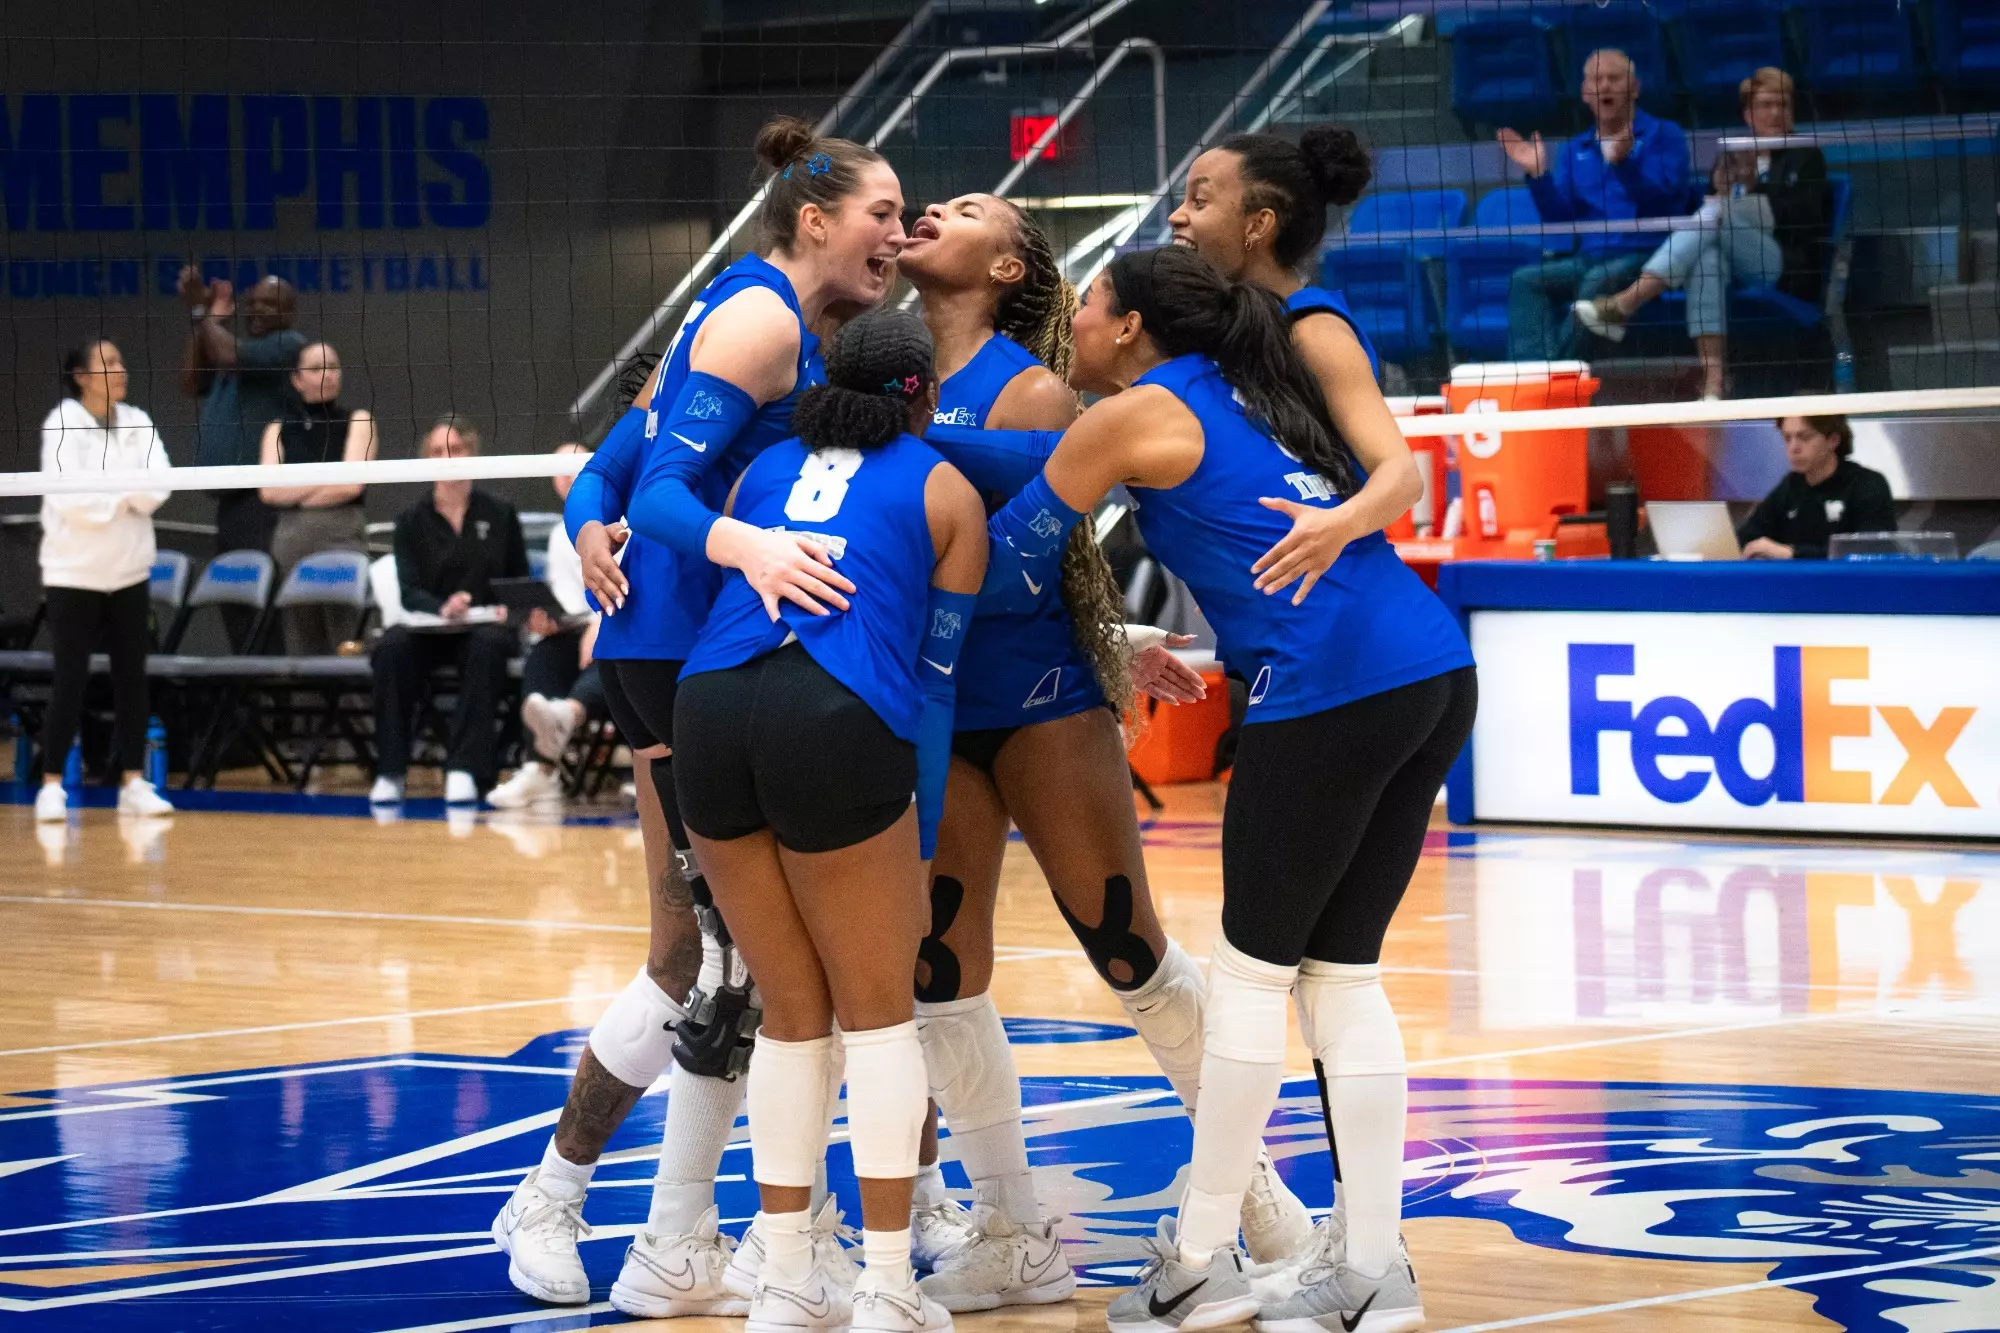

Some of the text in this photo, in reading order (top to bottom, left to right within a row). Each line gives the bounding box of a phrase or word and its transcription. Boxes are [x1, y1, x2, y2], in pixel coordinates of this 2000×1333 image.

[0, 94, 491, 231] MEMPHIS
[784, 447, 865, 523] 8
[1567, 642, 1981, 808] FedEx
